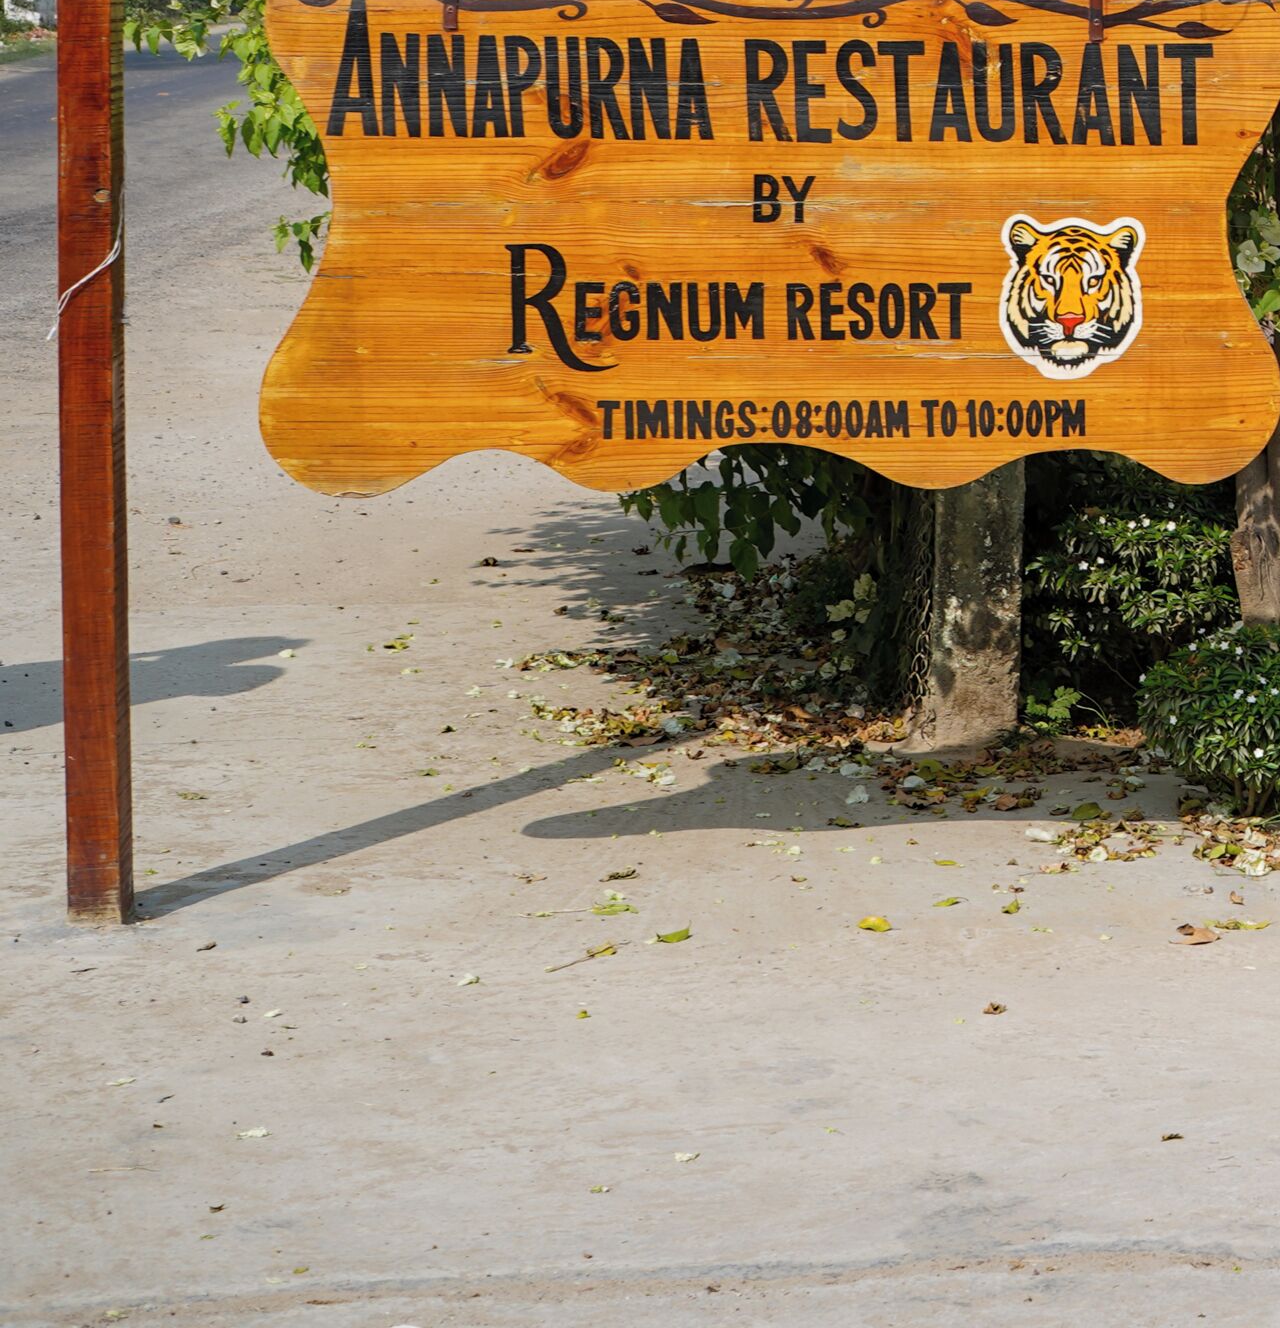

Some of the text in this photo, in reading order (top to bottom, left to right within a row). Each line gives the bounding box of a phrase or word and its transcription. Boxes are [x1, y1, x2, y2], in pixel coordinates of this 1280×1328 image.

[744, 38, 1214, 147] RESTAURANT
[752, 174, 815, 224] BY
[505, 243, 972, 372] REGNUM RESORT
[921, 399, 957, 438] TO
[966, 399, 1086, 438] 10:00PM
